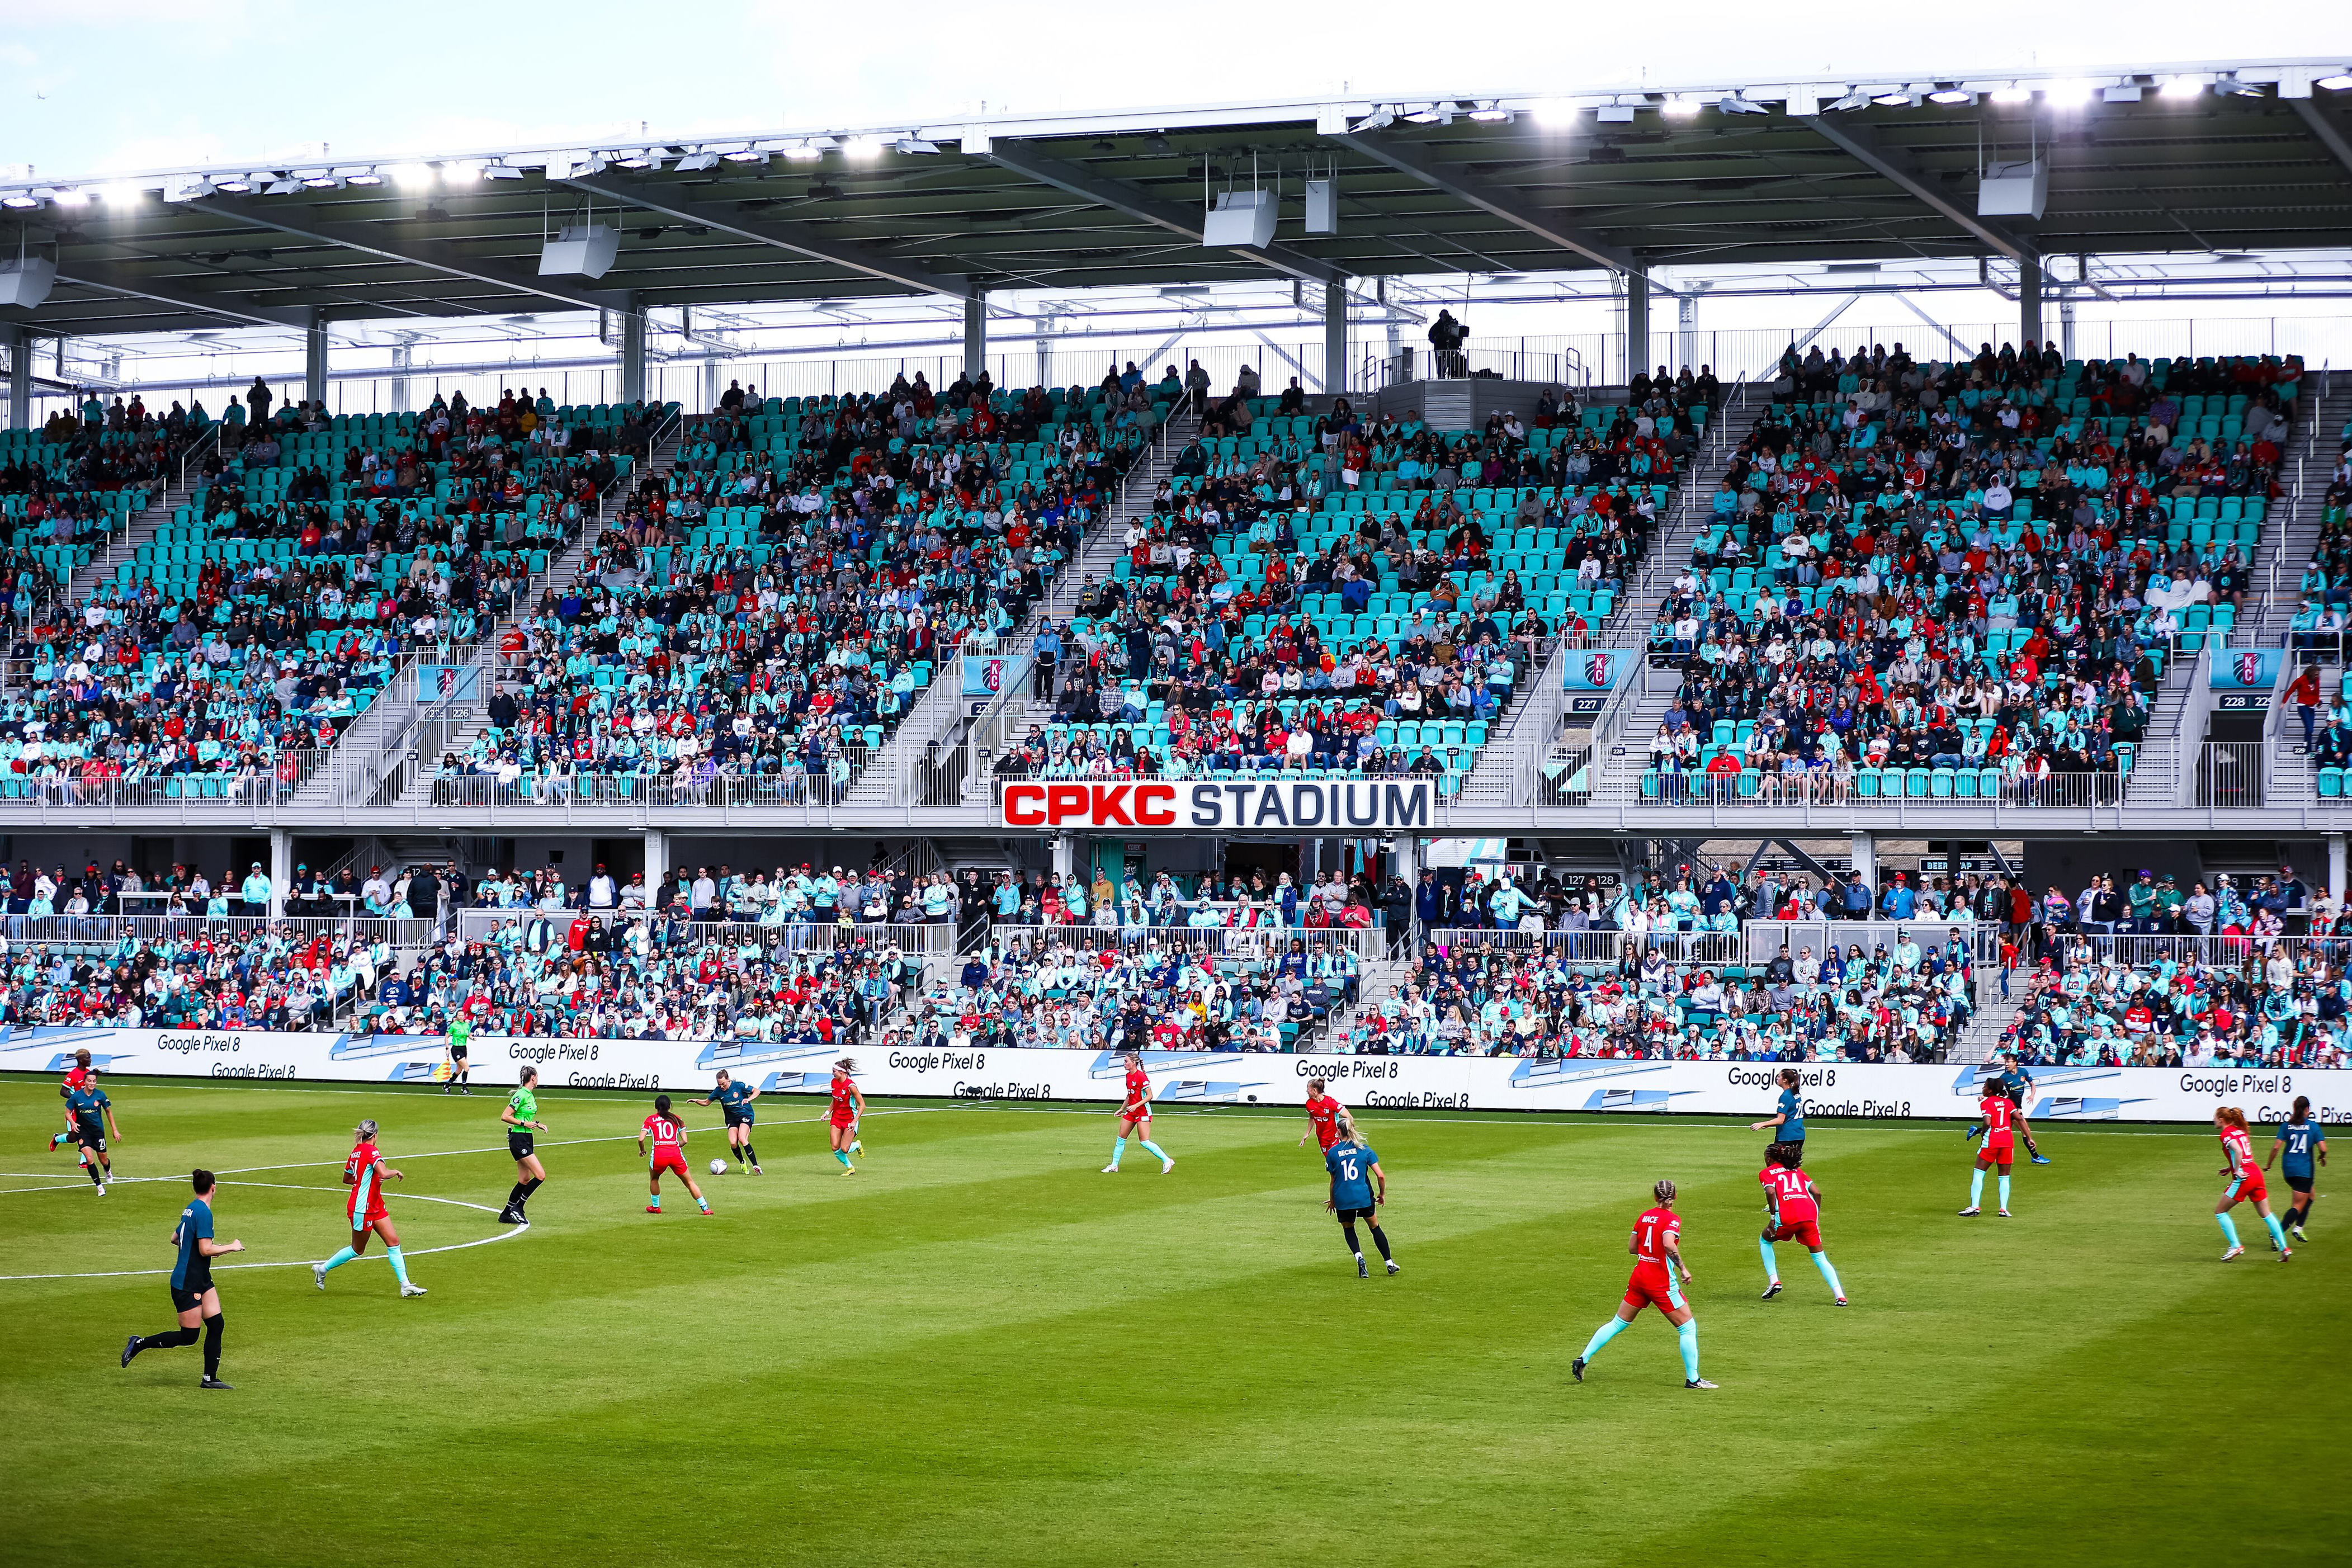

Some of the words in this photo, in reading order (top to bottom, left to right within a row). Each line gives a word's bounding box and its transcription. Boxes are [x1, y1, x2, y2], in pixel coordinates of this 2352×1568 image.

[991, 663, 998, 687] KC
[1595, 658, 1603, 682] KC
[2244, 657, 2252, 681] KC
[1578, 700, 1597, 709] 227
[2225, 697, 2245, 706] 228
[1004, 785, 1177, 825] CPKC
[1192, 785, 1428, 826] STADIUM
[1568, 875, 1585, 885] 127
[1597, 876, 1614, 885] 128
[158, 1035, 200, 1054] Google
[203, 1036, 231, 1051] Pixel
[232, 1037, 240, 1051] 8
[509, 1043, 556, 1064] Google
[559, 1044, 588, 1060] Pixel
[591, 1045, 599, 1060] 8
[258, 1064, 286, 1078] Pixel
[287, 1065, 295, 1079] 8
[889, 1052, 939, 1073] Google
[942, 1053, 974, 1069] Pixel
[976, 1054, 985, 1070] 8
[1296, 1060, 1349, 1082] Google
[1353, 1061, 1386, 1078] Pixel
[1388, 1062, 1398, 1079] 8
[619, 1073, 649, 1088] Pixel
[651, 1075, 659, 1088] 8
[1797, 1069, 1823, 1087] ixel
[1826, 1070, 1835, 1087] 8
[2180, 1074, 2238, 1098] Google
[2242, 1075, 2278, 1093] Pixel
[2282, 1076, 2291, 1093] 8
[1008, 1083, 1039, 1098] Pixel
[1042, 1084, 1051, 1098] 8
[1423, 1092, 1457, 1107] Pixel
[1460, 1093, 1469, 1108] 8
[1863, 1101, 1898, 1116] Pixel
[1901, 1102, 1911, 1117] 8
[1997, 1108, 2005, 1125] 7
[2259, 1106, 2316, 1122] Gooe
[656, 1122, 674, 1140] 10
[1338, 1147, 1358, 1157] BECKIE
[2289, 1134, 2308, 1154] 24
[1341, 1159, 1358, 1181] 16
[1777, 1174, 1802, 1193] 24
[1642, 1216, 1659, 1224] MACE
[1645, 1226, 1652, 1253] 4
